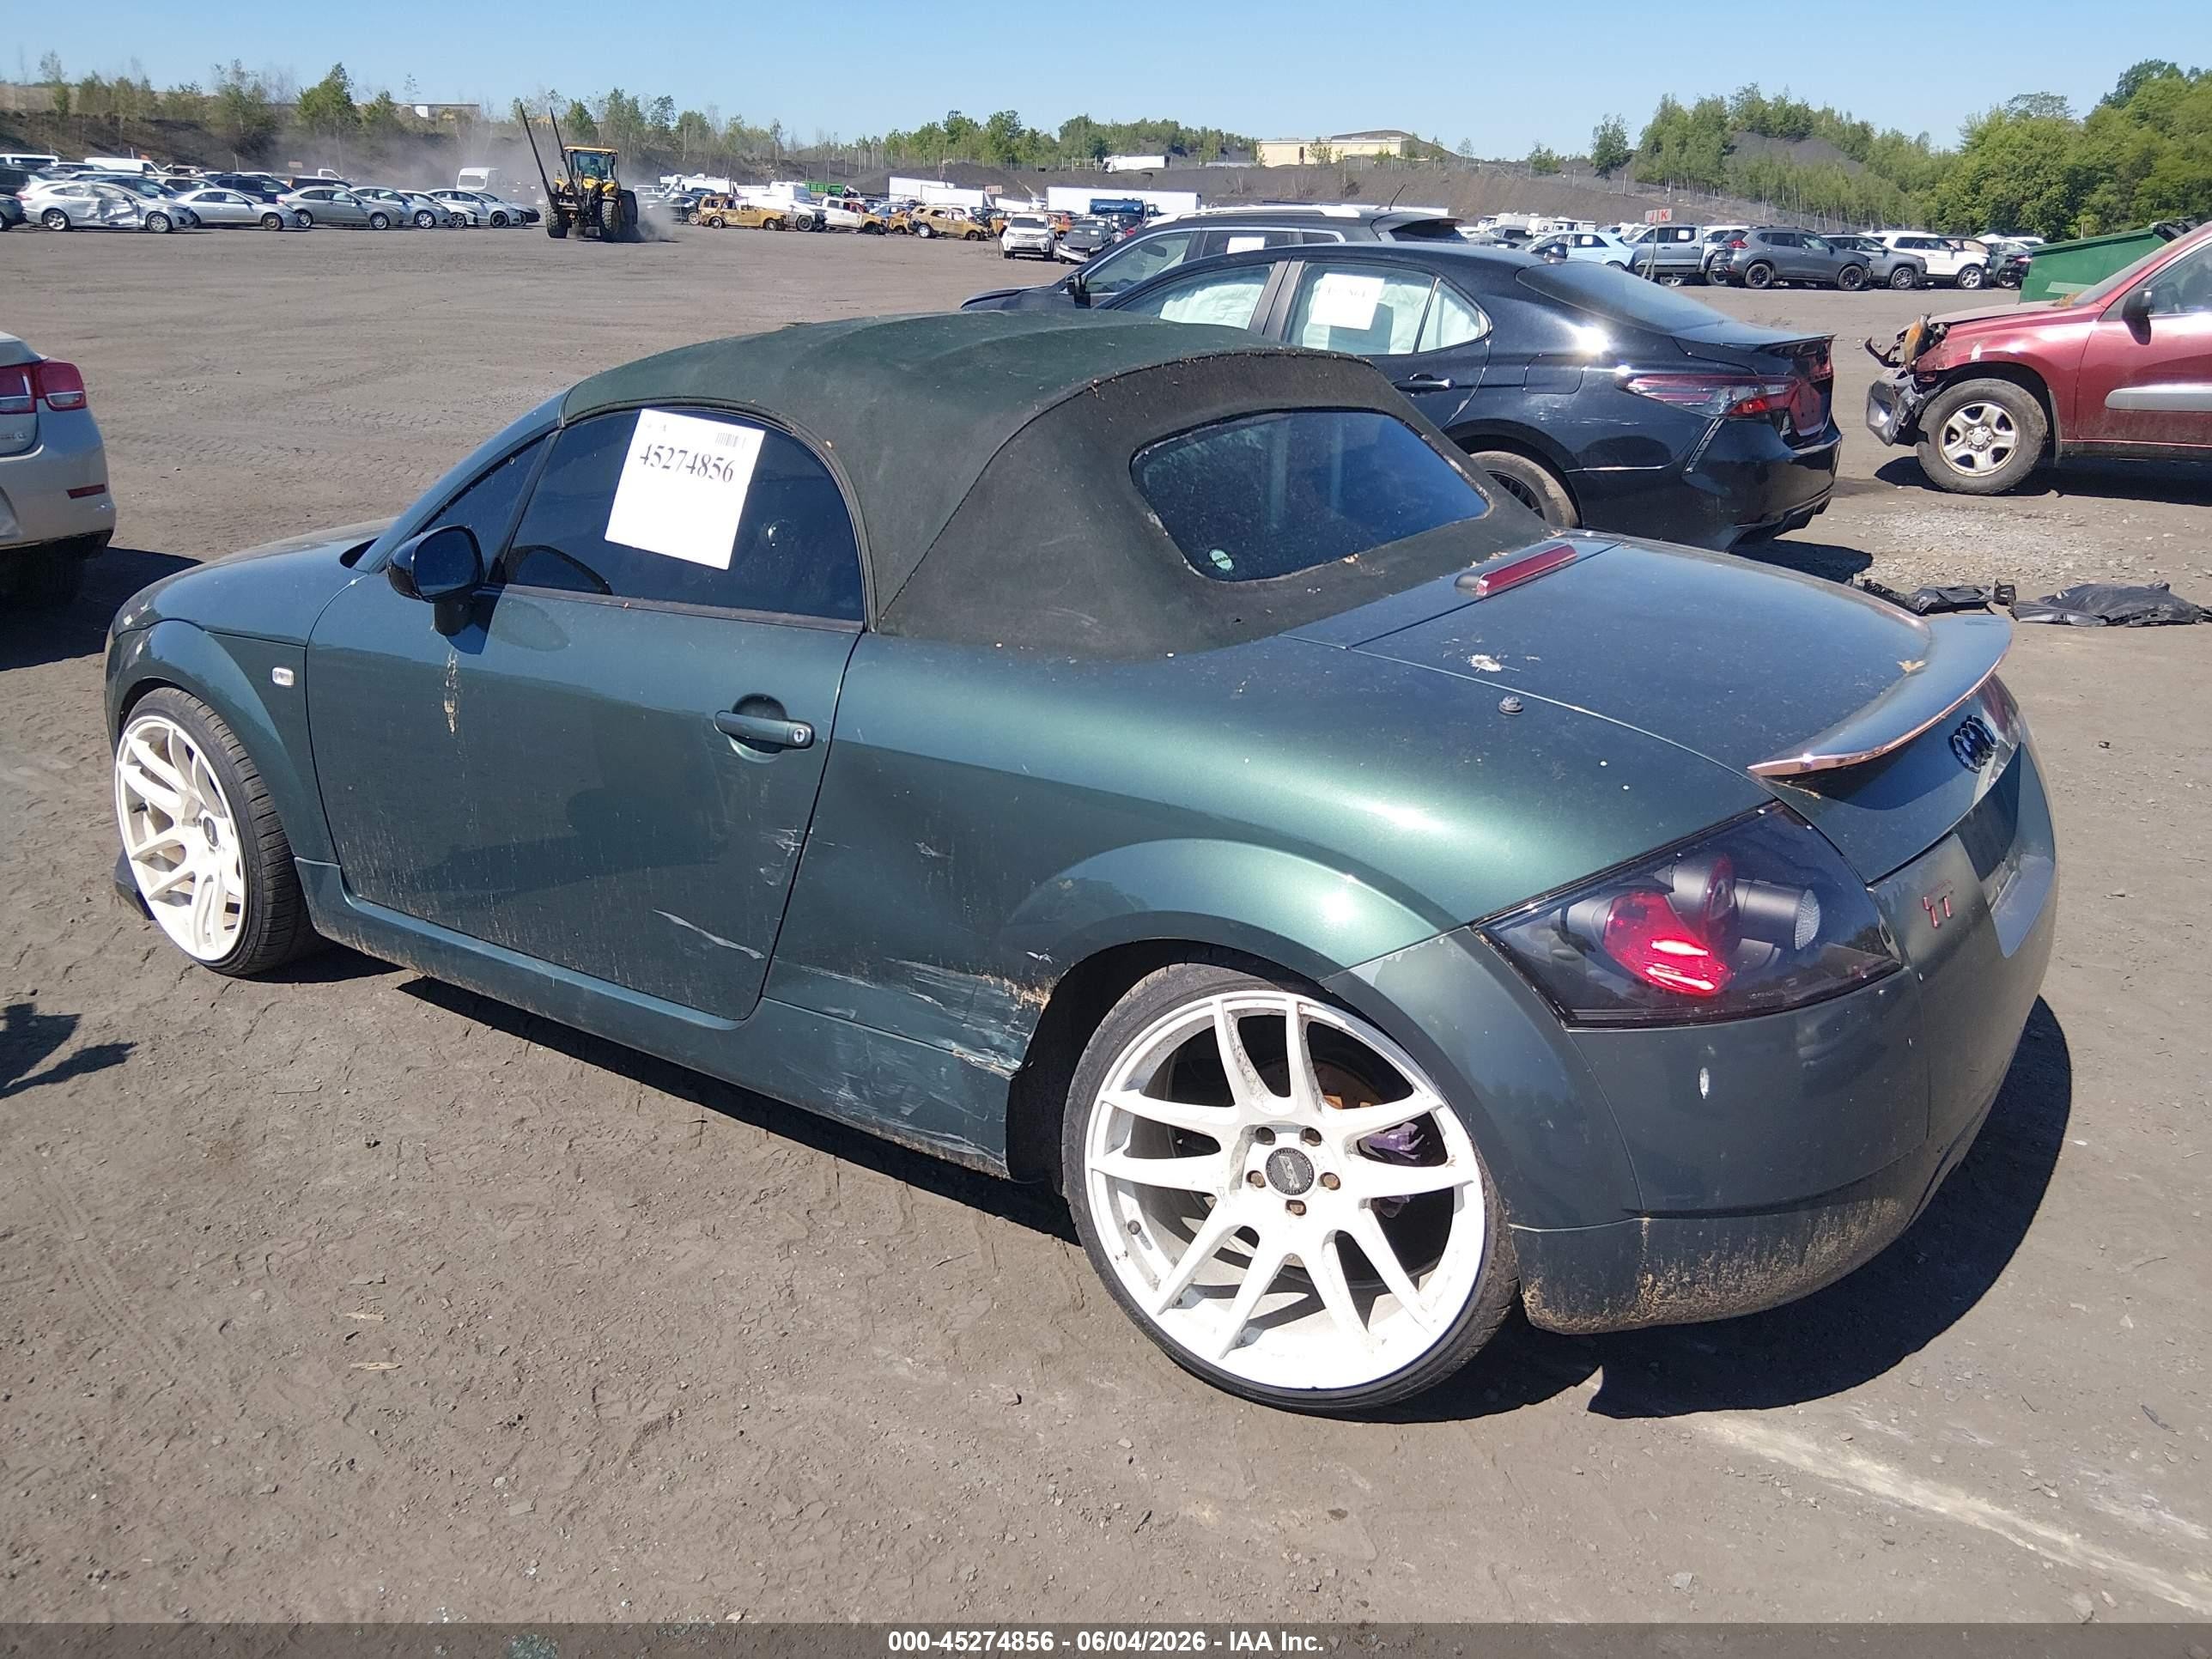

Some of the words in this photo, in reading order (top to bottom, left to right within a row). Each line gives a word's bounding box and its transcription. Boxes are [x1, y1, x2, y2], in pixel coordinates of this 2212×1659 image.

[1648, 211, 1655, 222] J
[1661, 210, 1668, 221] K
[640, 444, 736, 483] 45274856
